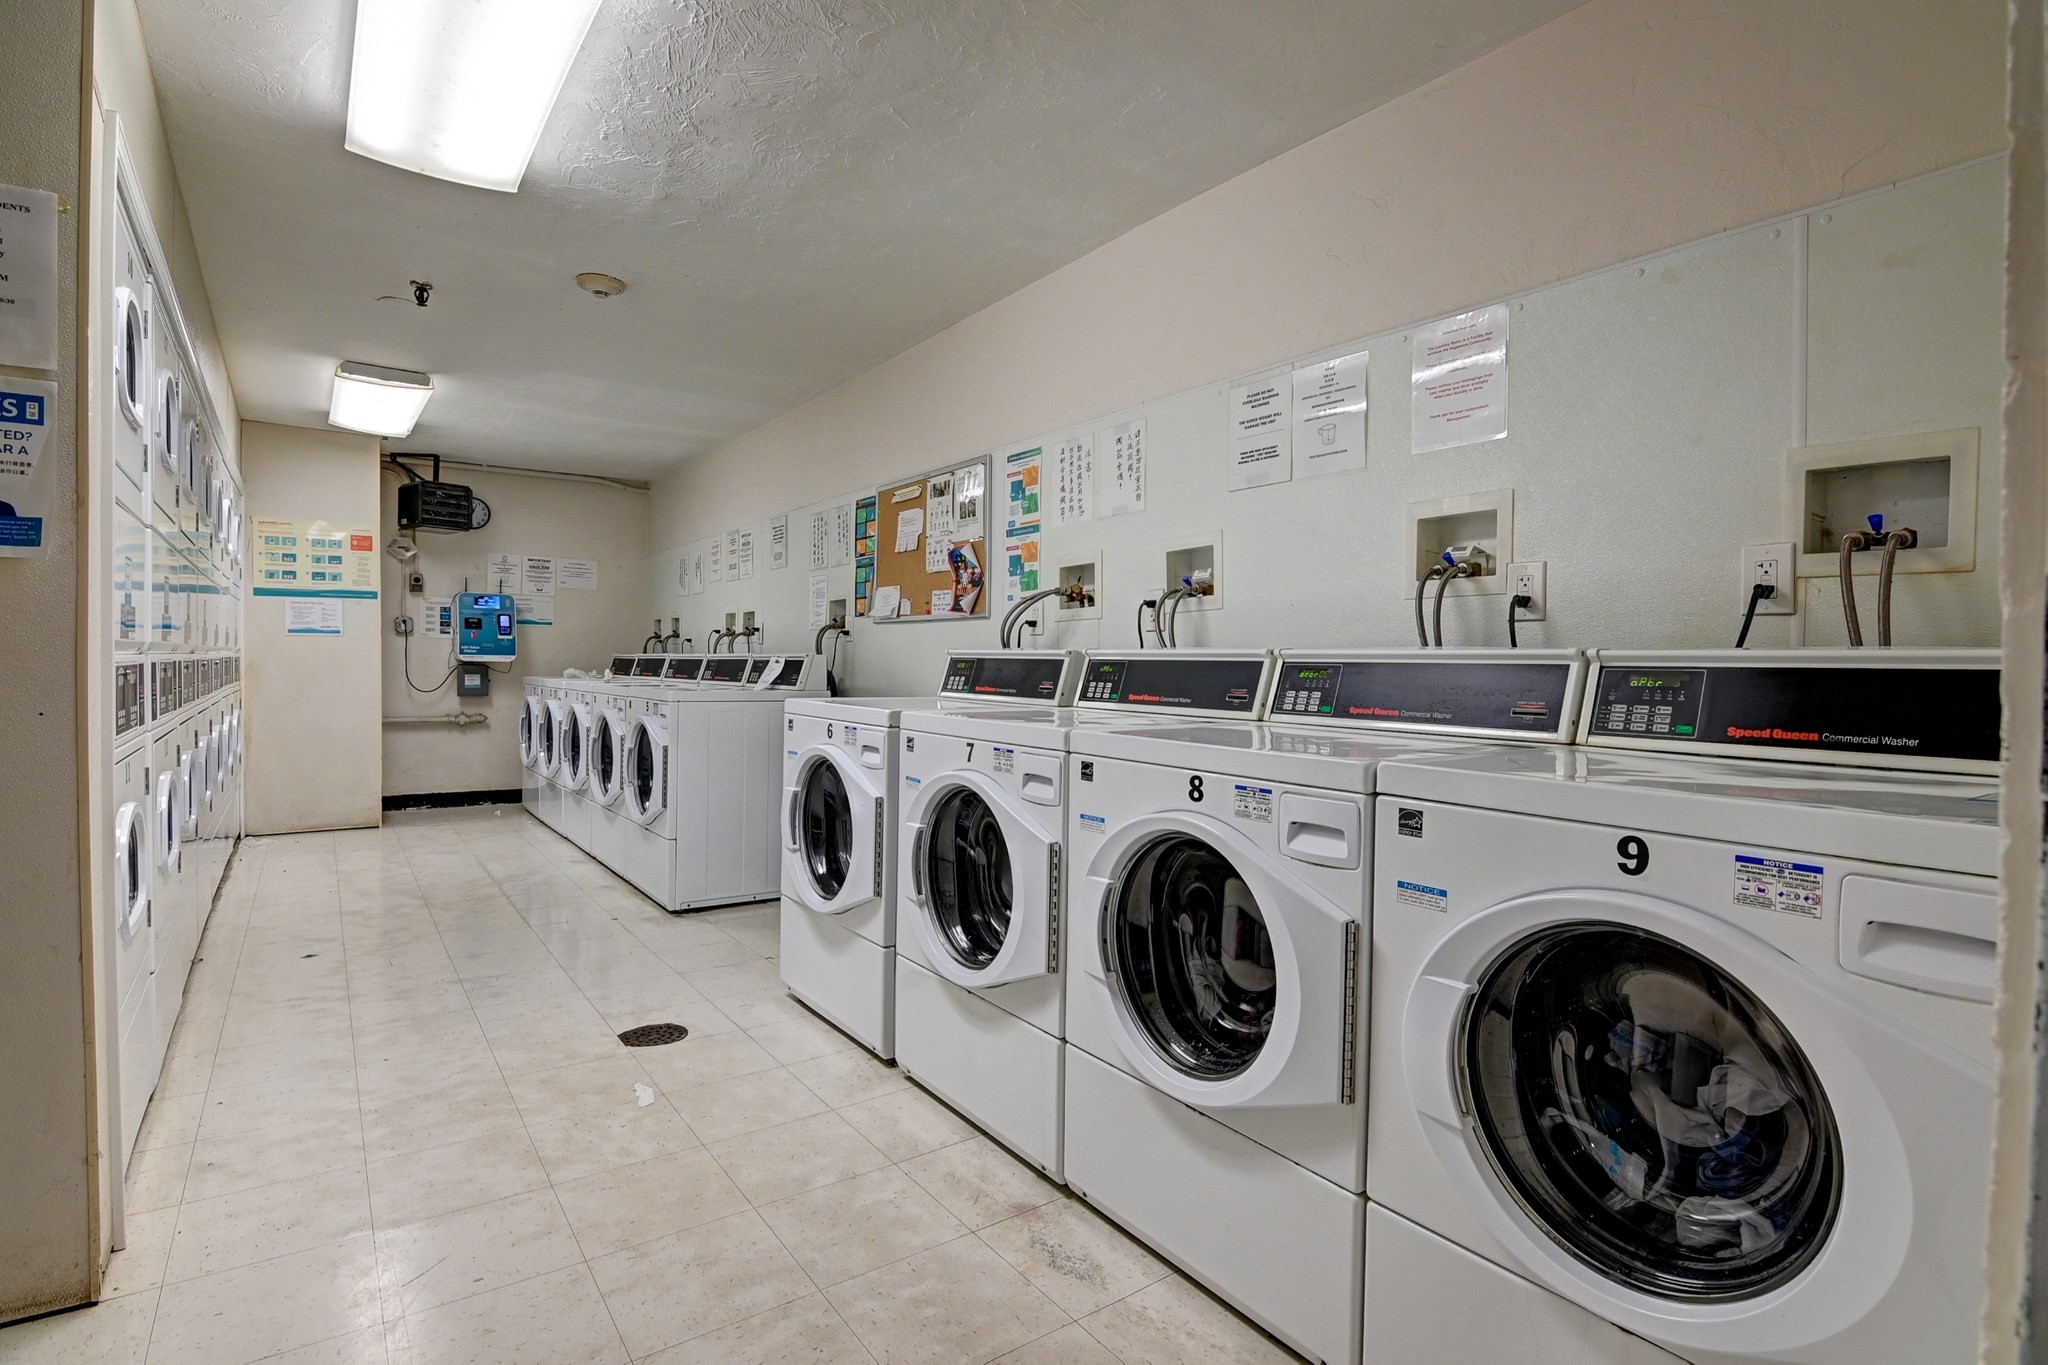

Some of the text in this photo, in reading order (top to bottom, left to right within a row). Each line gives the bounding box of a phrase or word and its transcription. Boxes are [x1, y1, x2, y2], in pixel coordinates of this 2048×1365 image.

[0, 398, 18, 417] S
[18, 446, 28, 455] A
[1374, 708, 1399, 716] Queen
[827, 723, 833, 739] 6
[1727, 726, 1919, 747] Speed Queen Commercial Washer
[966, 742, 974, 762] 7
[1188, 775, 1204, 803] 8
[1617, 835, 1649, 876] 9
[1737, 868, 1768, 877] RECOMMENDED
[1763, 860, 1793, 869] NOTICE
[1404, 883, 1440, 895] NOTICE
